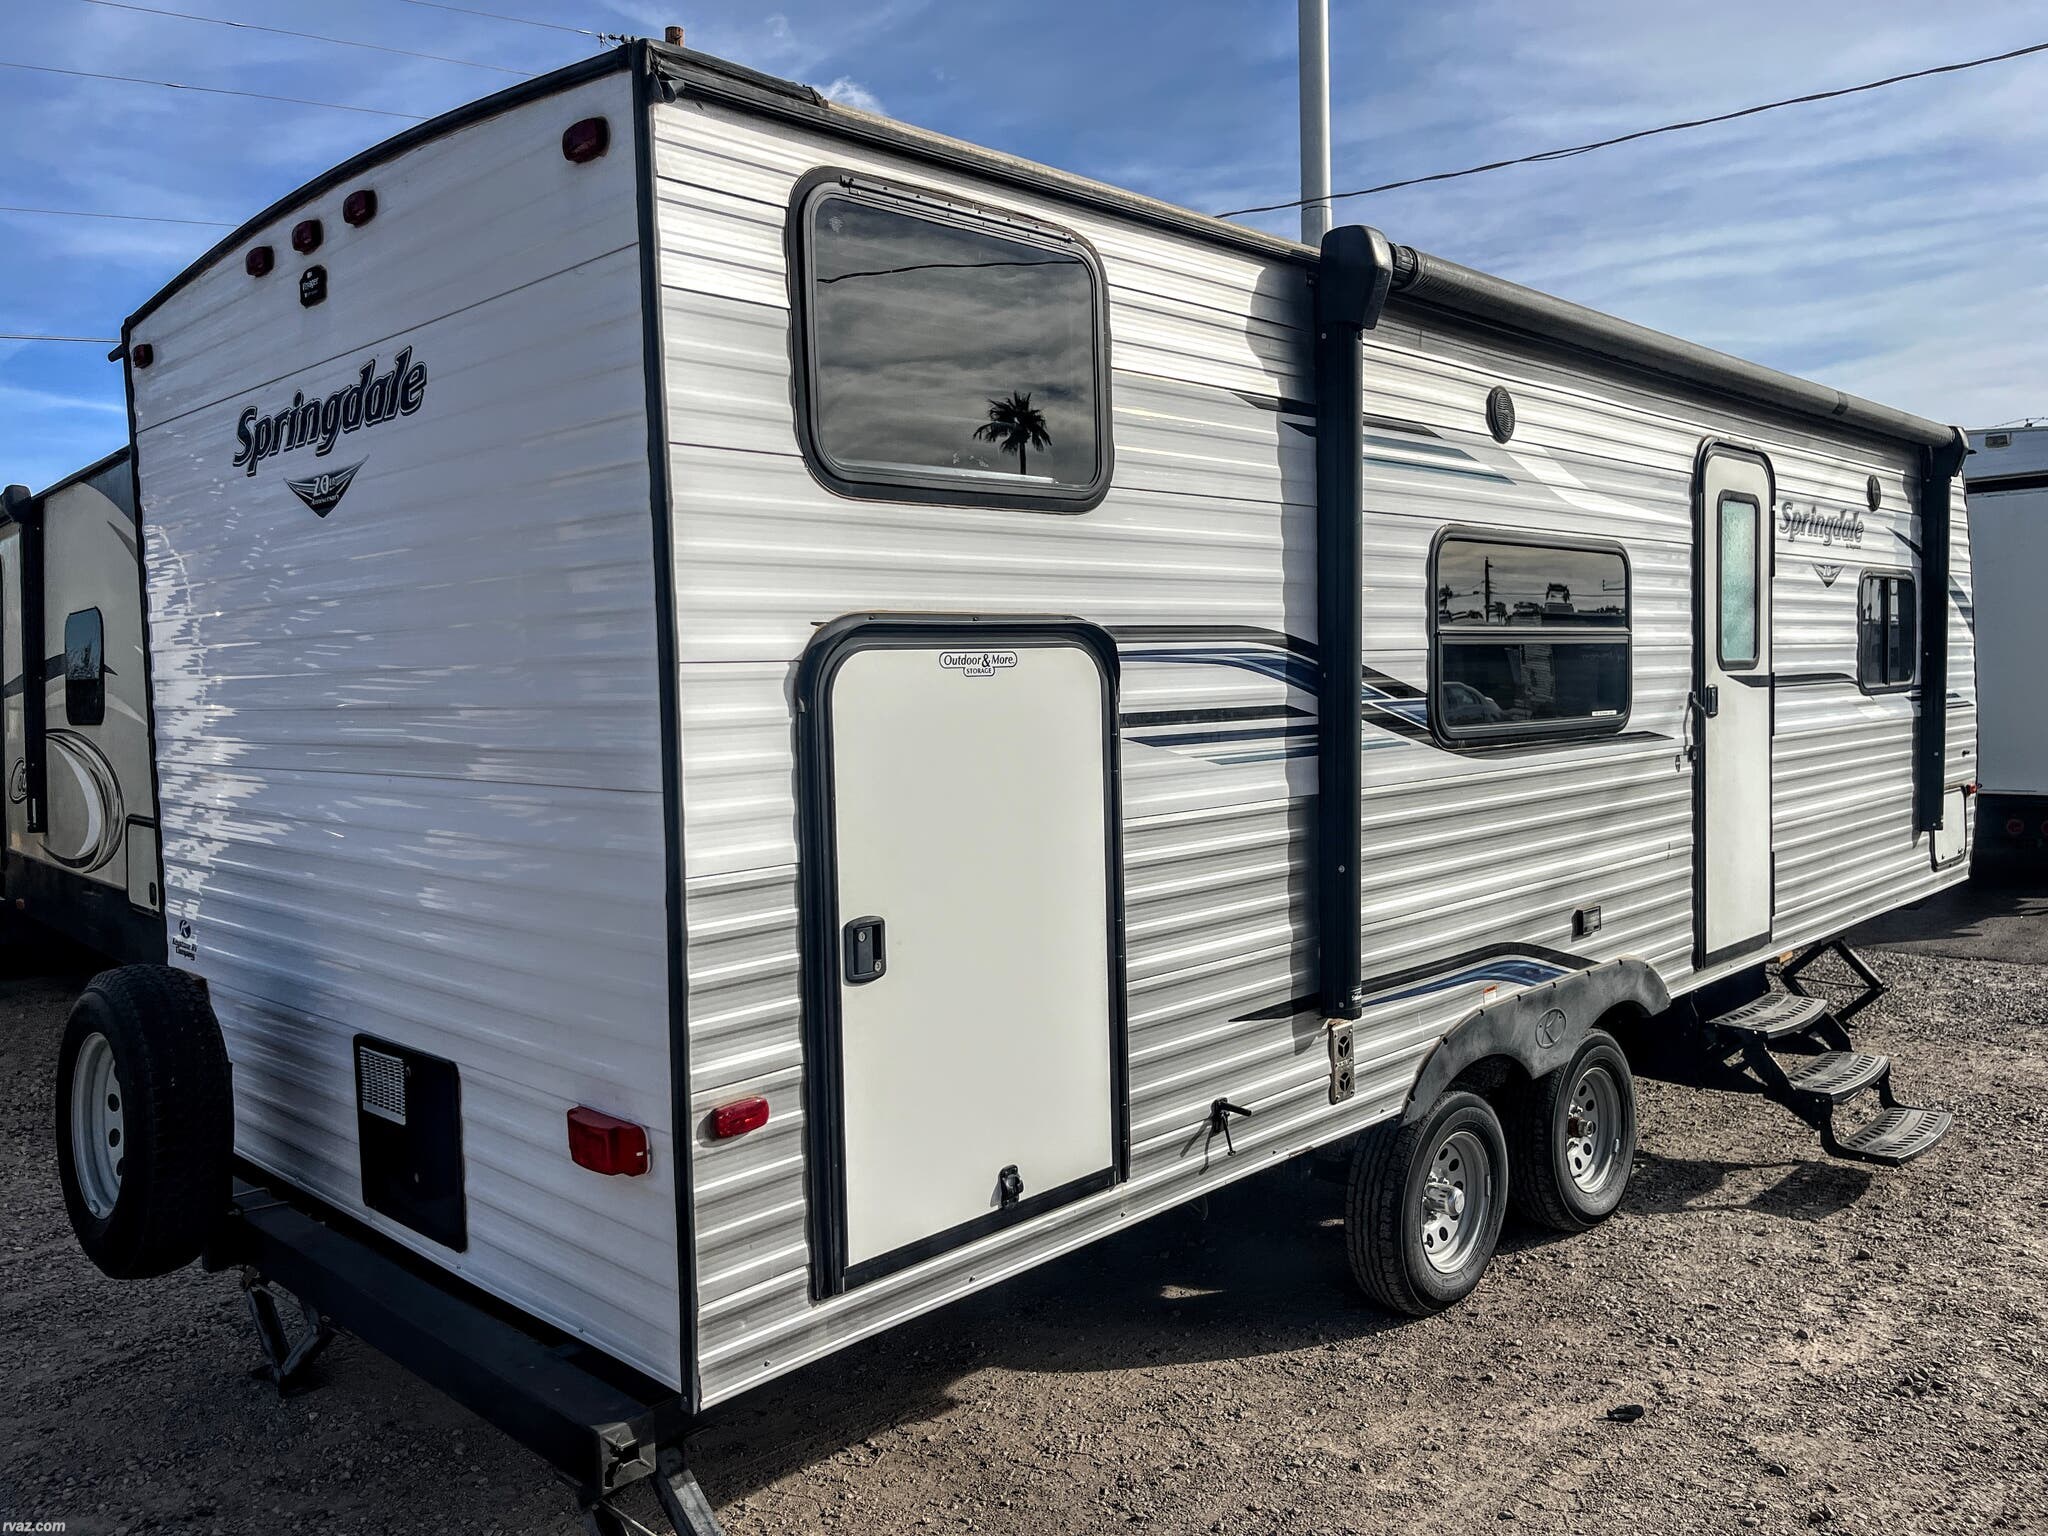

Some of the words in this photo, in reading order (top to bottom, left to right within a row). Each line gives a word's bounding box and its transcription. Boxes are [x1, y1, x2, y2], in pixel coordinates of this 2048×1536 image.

[233, 345, 428, 477] Springdale
[1779, 501, 1864, 546] Springdale
[966, 667, 992, 675] STORAGE
